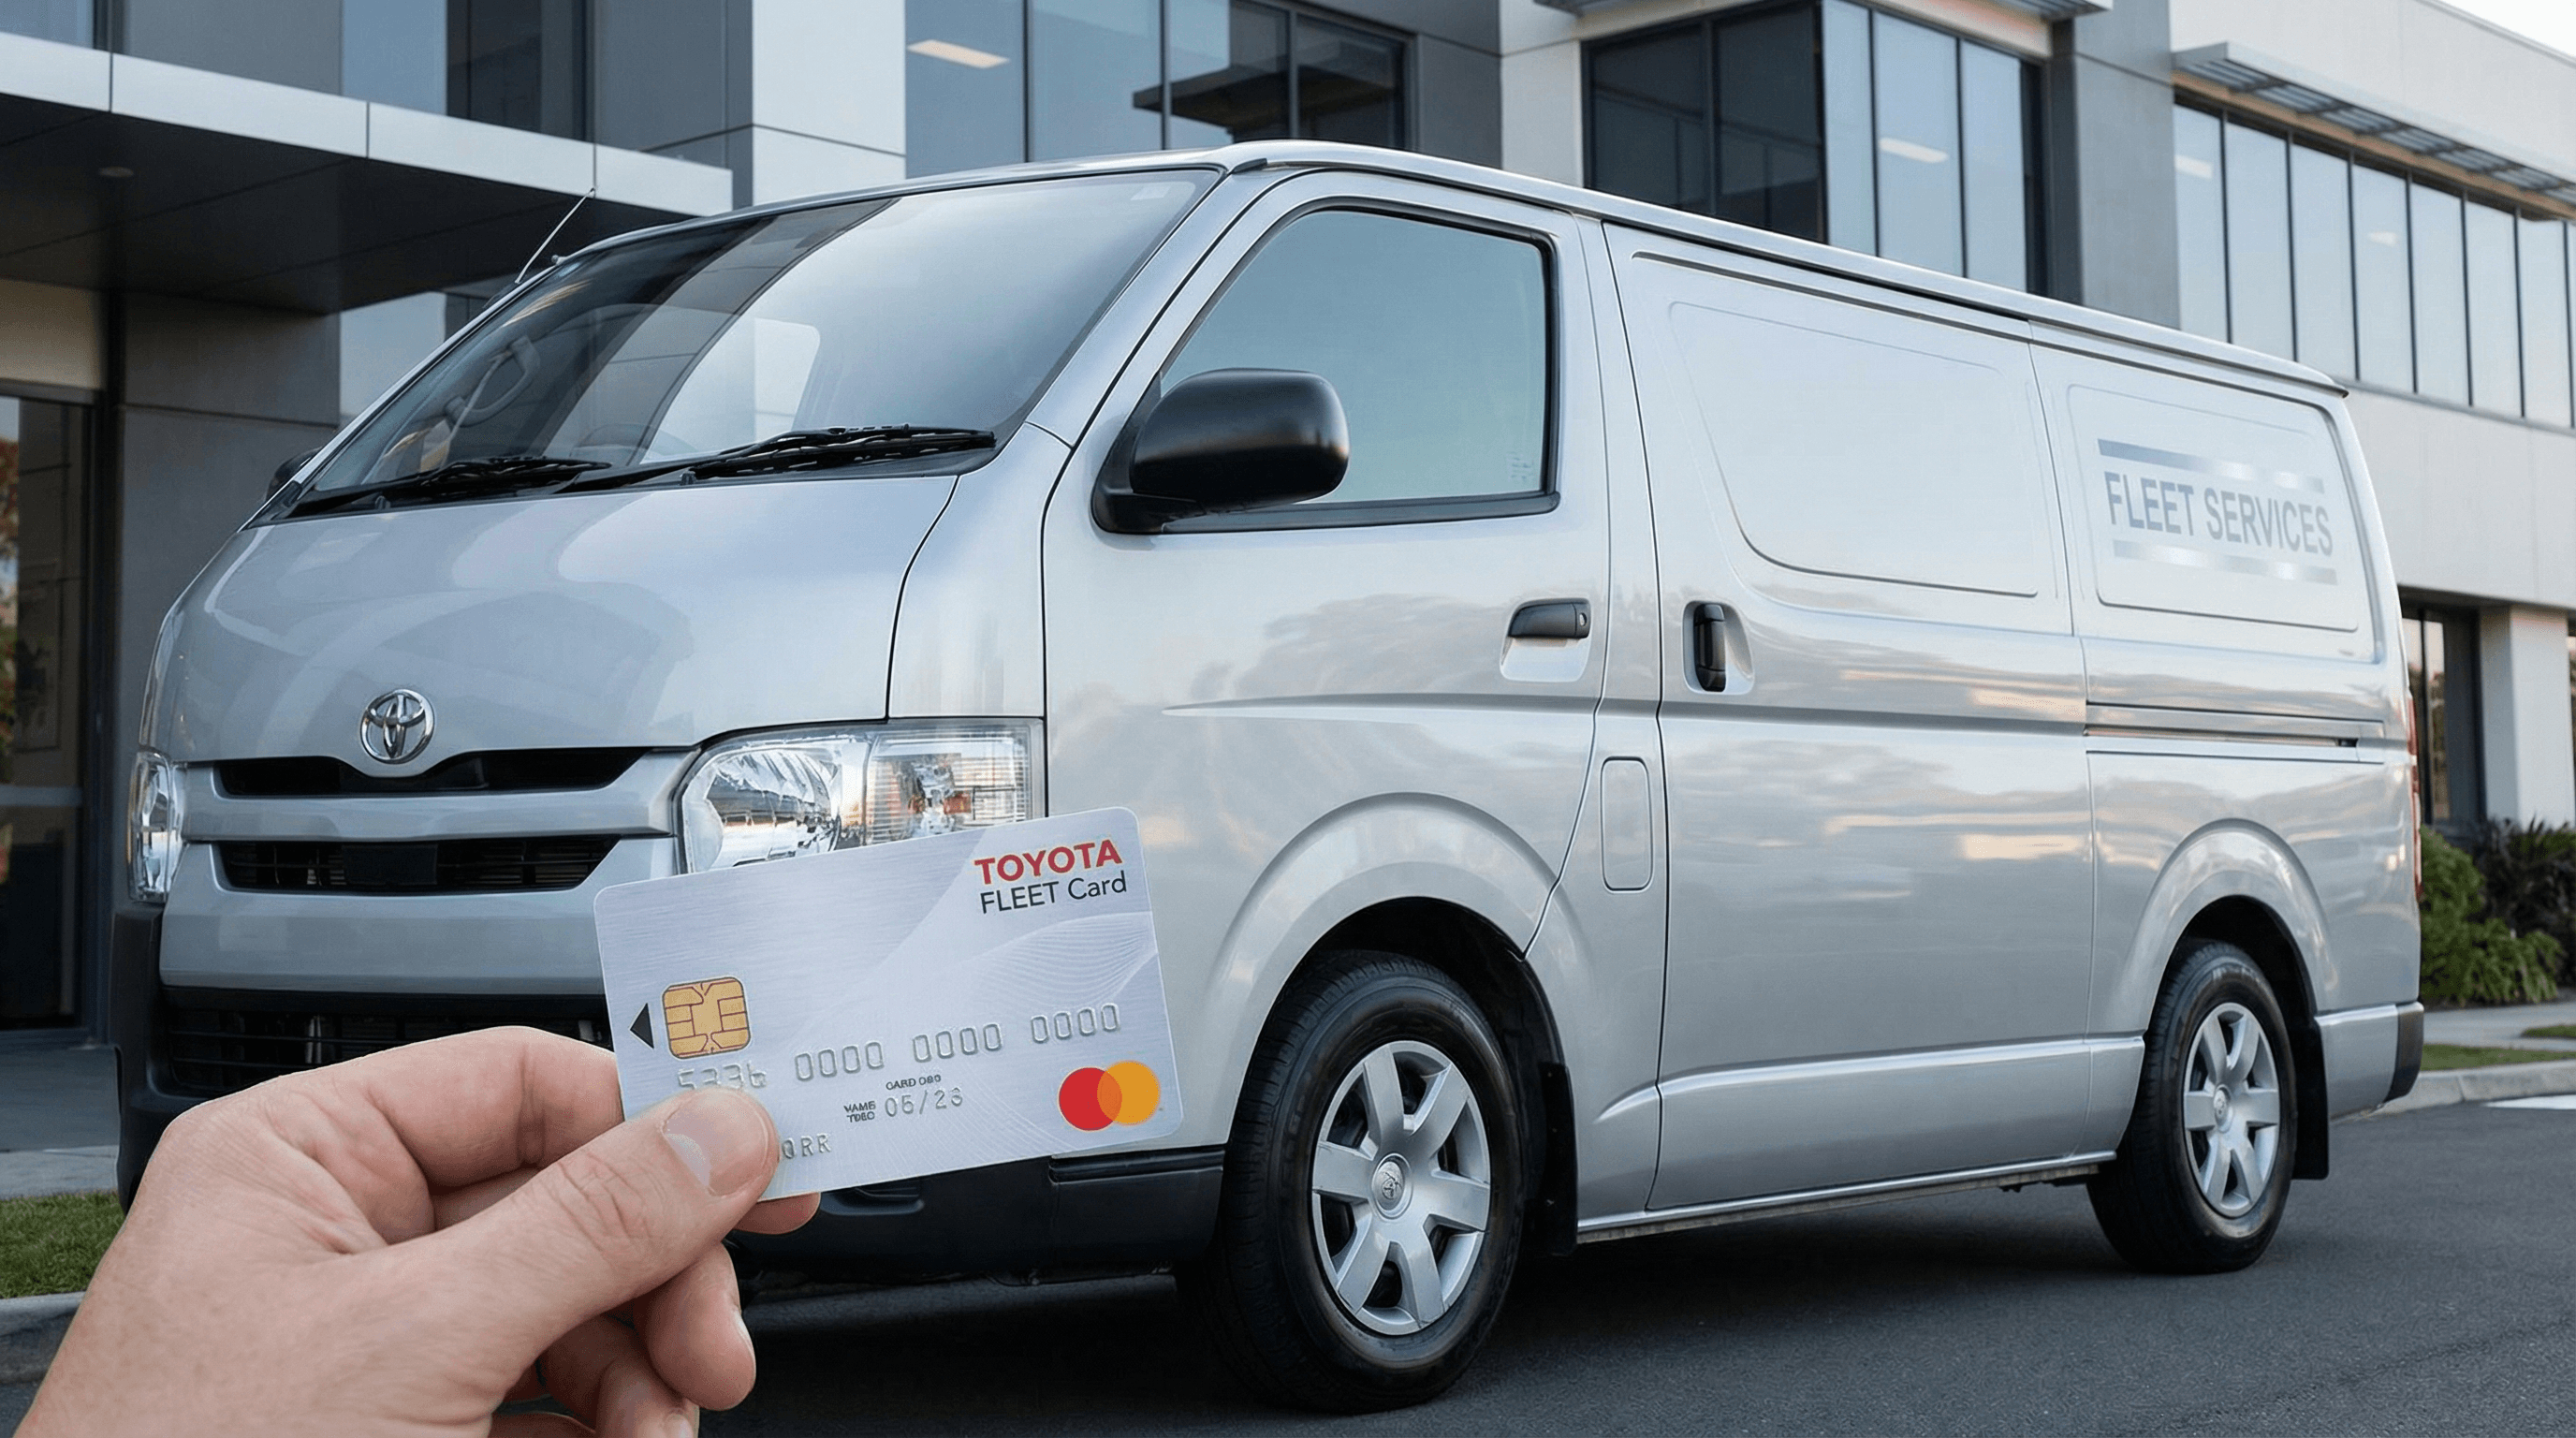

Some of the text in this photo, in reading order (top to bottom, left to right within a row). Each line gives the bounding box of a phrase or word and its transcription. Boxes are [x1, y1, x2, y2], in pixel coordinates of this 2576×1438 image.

[2104, 471, 2333, 556] FLEET SERVICES
[974, 839, 1122, 885] TOYOTA
[980, 870, 1127, 914] FLEET Card
[796, 1041, 885, 1081] 0000
[913, 1022, 1003, 1063] 0000
[1031, 1003, 1120, 1044] 0000
[886, 1078, 916, 1091] CARD
